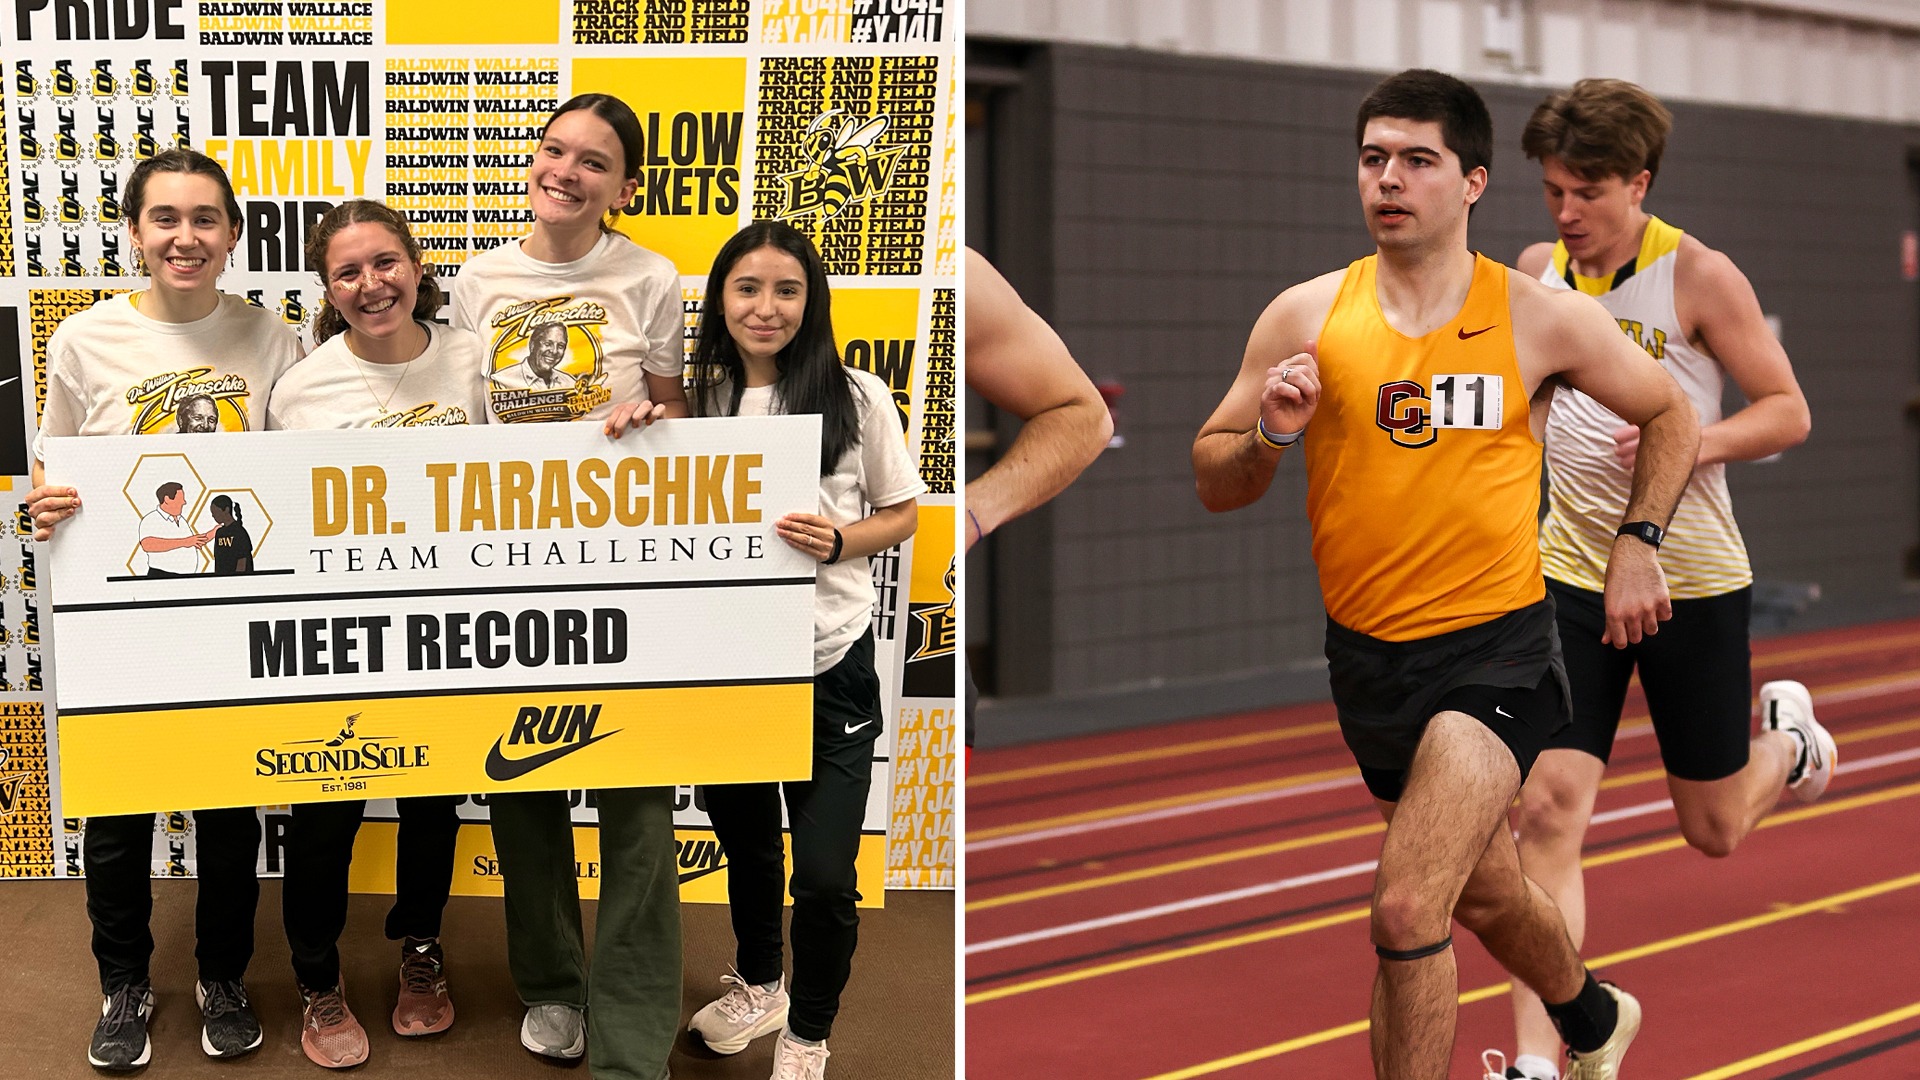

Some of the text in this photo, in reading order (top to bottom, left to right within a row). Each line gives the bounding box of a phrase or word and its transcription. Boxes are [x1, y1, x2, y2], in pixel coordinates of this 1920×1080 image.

[199, 2, 372, 16] BALDWIN WALLACE
[574, 0, 639, 14] TRACK
[644, 0, 686, 14] AND
[691, 0, 750, 14] FIELD
[199, 17, 372, 30] BALDWIN WALLACE
[573, 15, 749, 29] TRACK AND FIELD
[199, 32, 372, 45] BALDWIN WALLACE
[572, 30, 748, 44] TRACK AND FIELD
[385, 58, 559, 70] BALDWIN WALLACE
[760, 56, 938, 70] TRACK AND FIELD
[16, 60, 35, 94] OA
[55, 60, 74, 94] OA
[95, 59, 112, 94] OA
[135, 59, 152, 93] OA
[385, 72, 558, 85] BALDWIN WALLACE
[760, 70, 937, 84] TRACK AND FIELD
[201, 60, 370, 136] TEAM
[385, 86, 558, 98] BALDWIN WALLACE
[759, 85, 936, 99] TRACK AND FIELD
[385, 100, 558, 112] BALDWIN WALLACE
[758, 100, 935, 114] TRACK AND FIELD
[386, 114, 469, 126] BALDWIN
[890, 115, 933, 128] IELD
[18, 107, 37, 158] OAC
[58, 107, 76, 158] OAC
[97, 106, 116, 158] OAC
[386, 127, 545, 140] BALDWIN WALLAC
[647, 112, 743, 166] LOW
[756, 130, 807, 144] TRAC
[386, 140, 540, 154] BALDWIN WALLA
[756, 146, 806, 159] TRAC
[386, 155, 534, 168] BALDWIN WALLA
[755, 160, 930, 173] TRAC ELD
[386, 169, 468, 181] BALDWIN
[892, 174, 929, 188] ELD
[22, 170, 41, 220] OAC
[62, 170, 80, 220] OAC
[100, 170, 118, 220] OAC
[386, 182, 468, 195] BALDWIN
[620, 168, 740, 216] CKETS
[401, 210, 536, 222] ALDWIN WALLA
[870, 204, 927, 217] FIELD
[410, 224, 533, 236] LDWIN WALLA
[821, 219, 862, 232] AND
[868, 219, 925, 232] FIELD
[417, 237, 467, 250] DWIN
[820, 234, 924, 248] AND FIELD
[421, 251, 466, 263] DWIN
[866, 248, 922, 261] FIELD
[865, 263, 922, 275] FIELD
[30, 290, 94, 304] CROSS
[30, 305, 92, 320] CROS
[492, 390, 528, 401] TEAM
[1436, 376, 1486, 426] 11
[492, 394, 564, 413] CHALLENGE
[312, 454, 763, 537] DR. TARASCHKE
[310, 536, 764, 573] TEAM CHALLENGE
[248, 608, 628, 678] MEET RECORD
[508, 704, 602, 745] RUN
[894, 786, 955, 813] #YJ4
[0, 824, 52, 837] NTRY
[892, 814, 955, 840] #YJ4
[0, 838, 54, 850] NTRY
[0, 851, 54, 864] NTRY
[889, 840, 955, 867] #YJ4
[0, 864, 55, 876] NTRY
